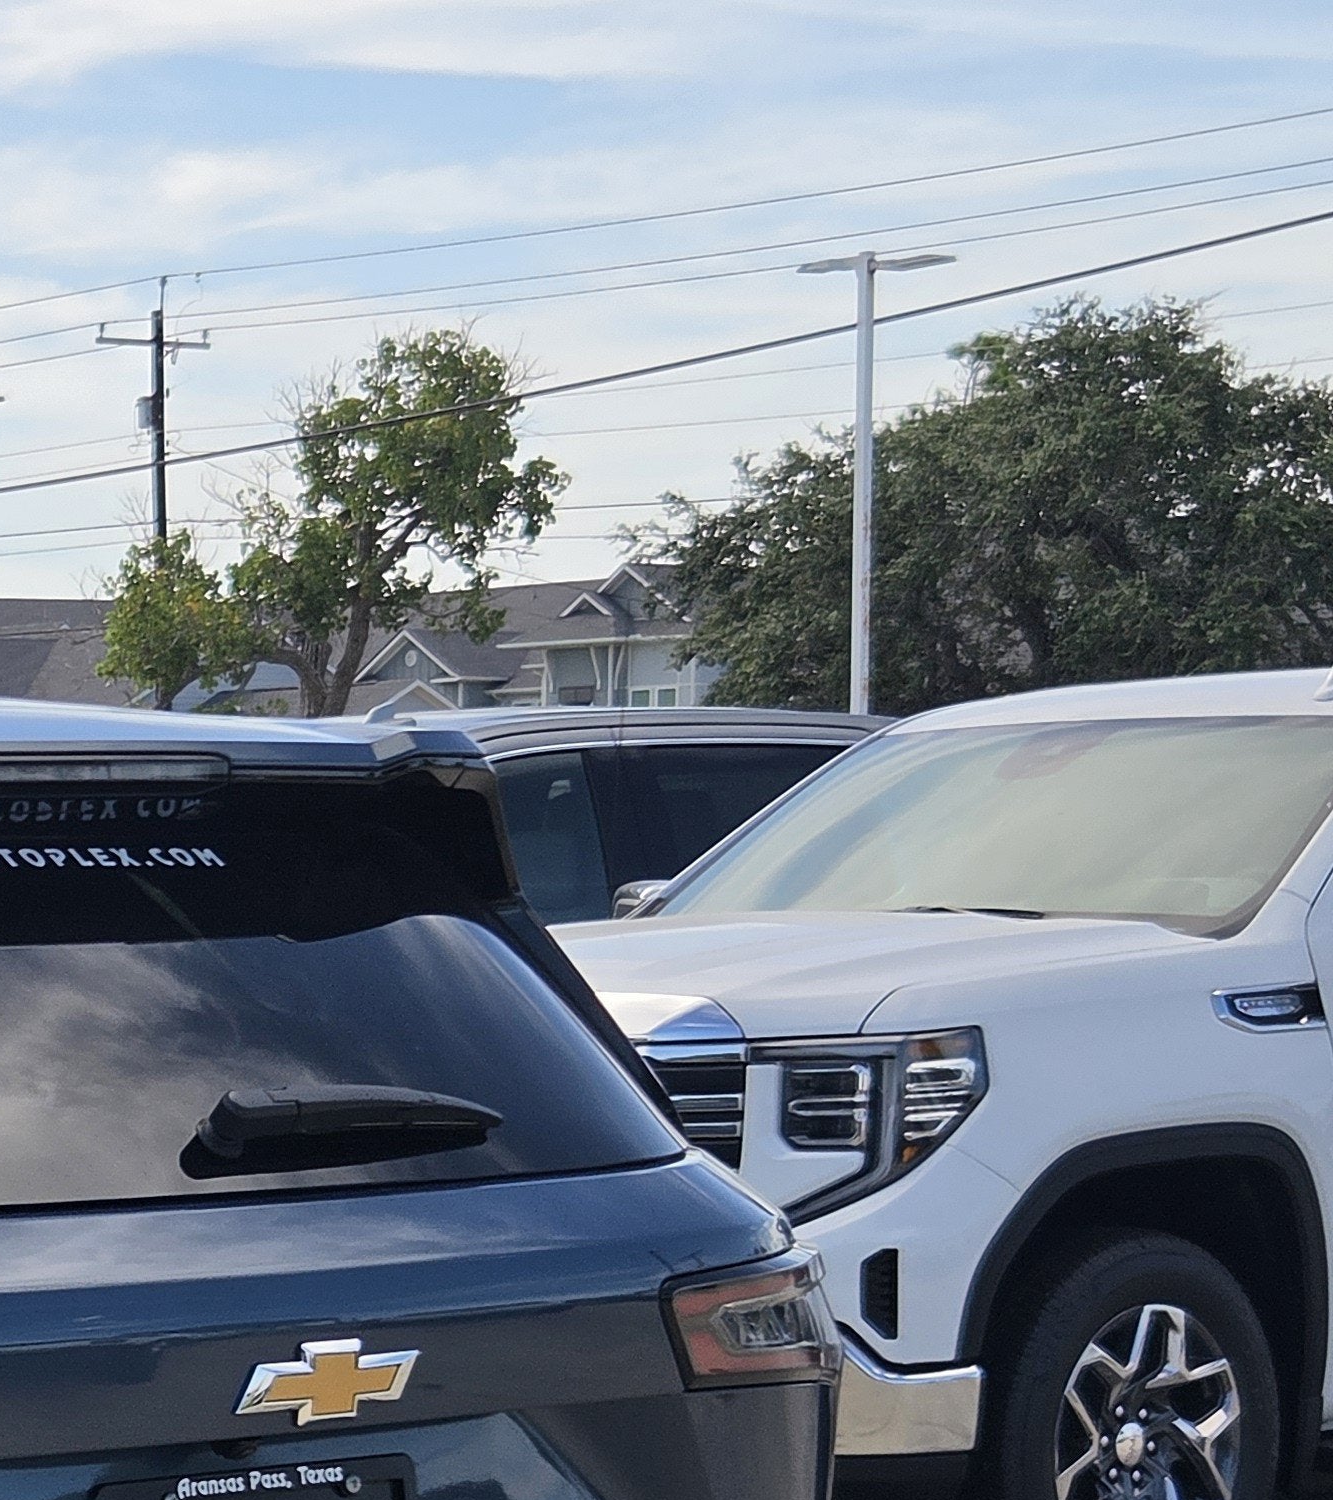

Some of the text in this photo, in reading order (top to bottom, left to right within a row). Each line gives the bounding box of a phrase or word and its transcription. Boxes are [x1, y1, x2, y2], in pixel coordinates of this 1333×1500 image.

[177, 1465, 344, 1500] Aransas Pass, Texas
